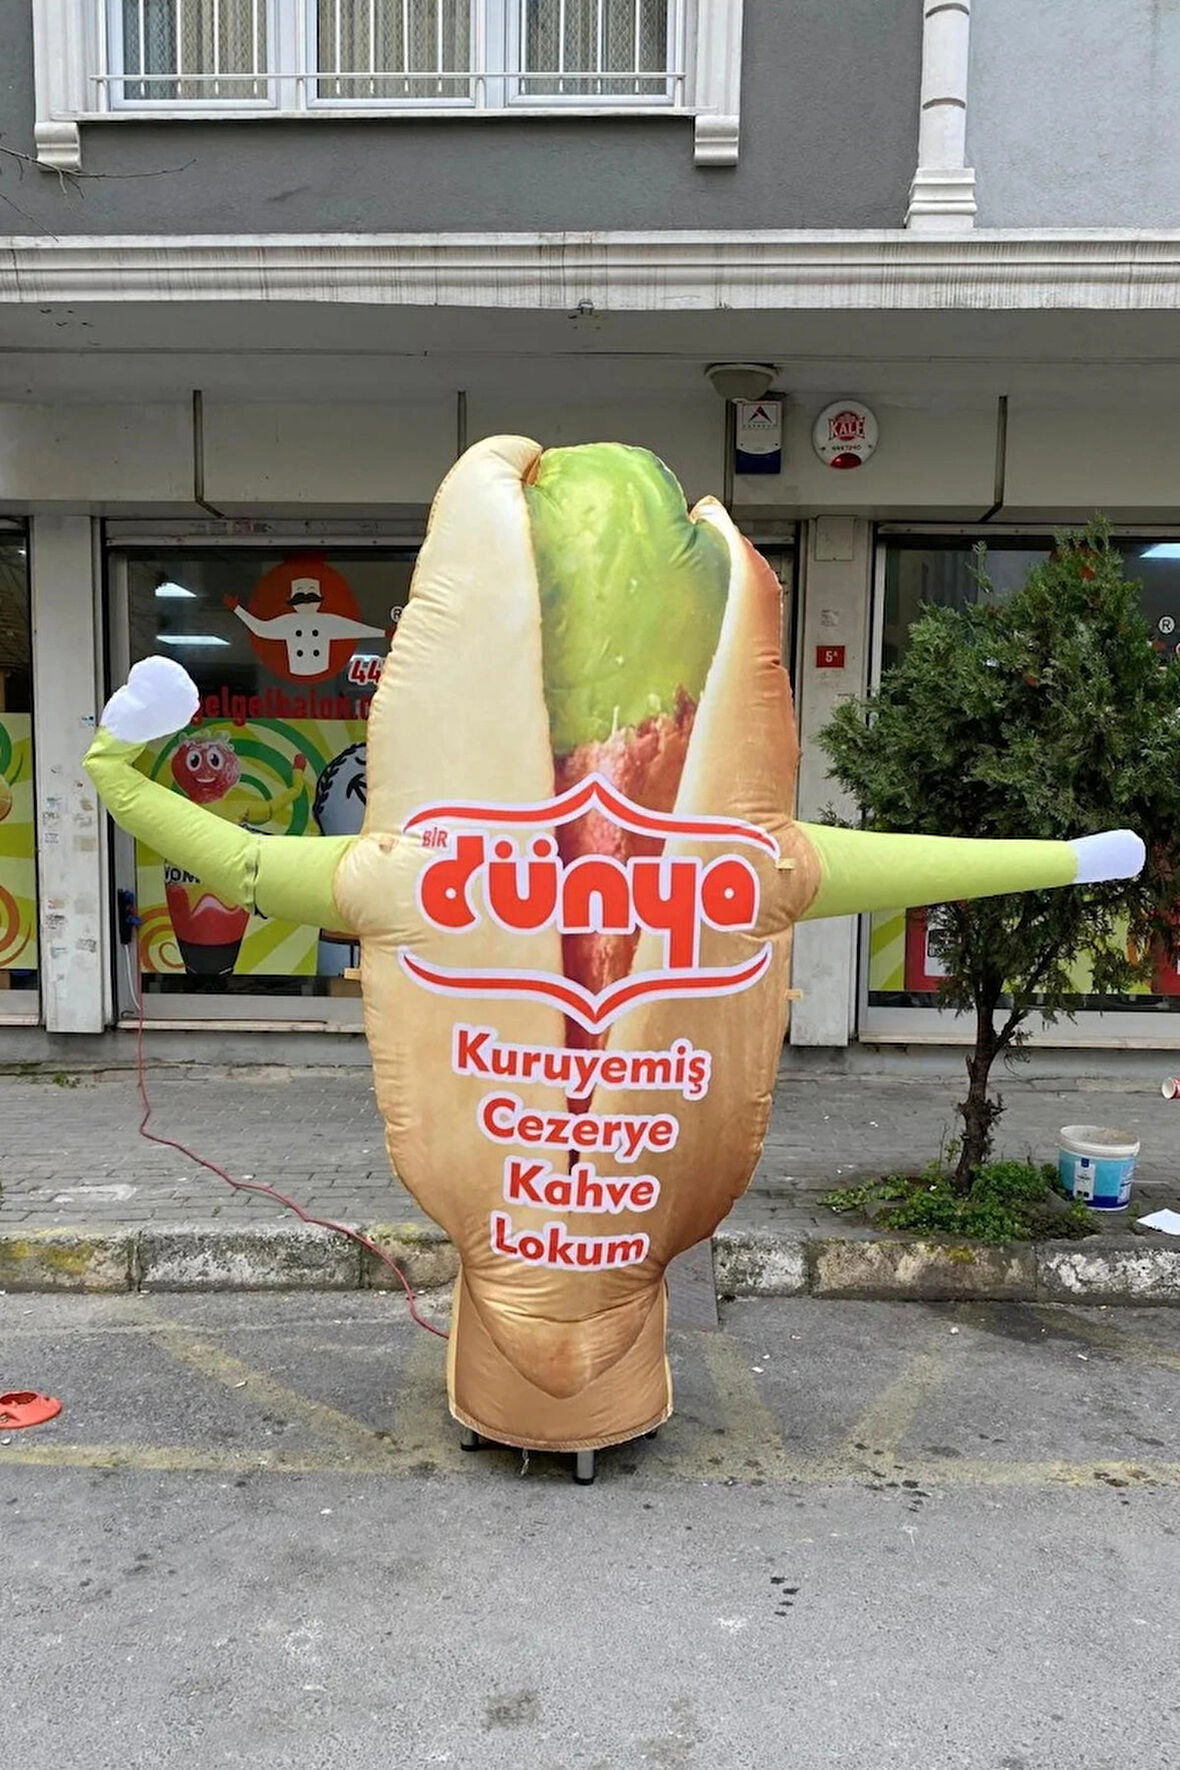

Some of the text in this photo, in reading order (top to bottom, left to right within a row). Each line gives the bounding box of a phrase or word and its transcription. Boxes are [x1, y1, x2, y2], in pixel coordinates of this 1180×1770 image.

[828, 416, 865, 440] KALE
[420, 835, 757, 969] dünya
[457, 1029, 706, 1095] Kuruyemiş
[482, 1097, 673, 1158] Cezerye
[508, 1161, 654, 1208] Kahve
[495, 1216, 645, 1266] Lokum
